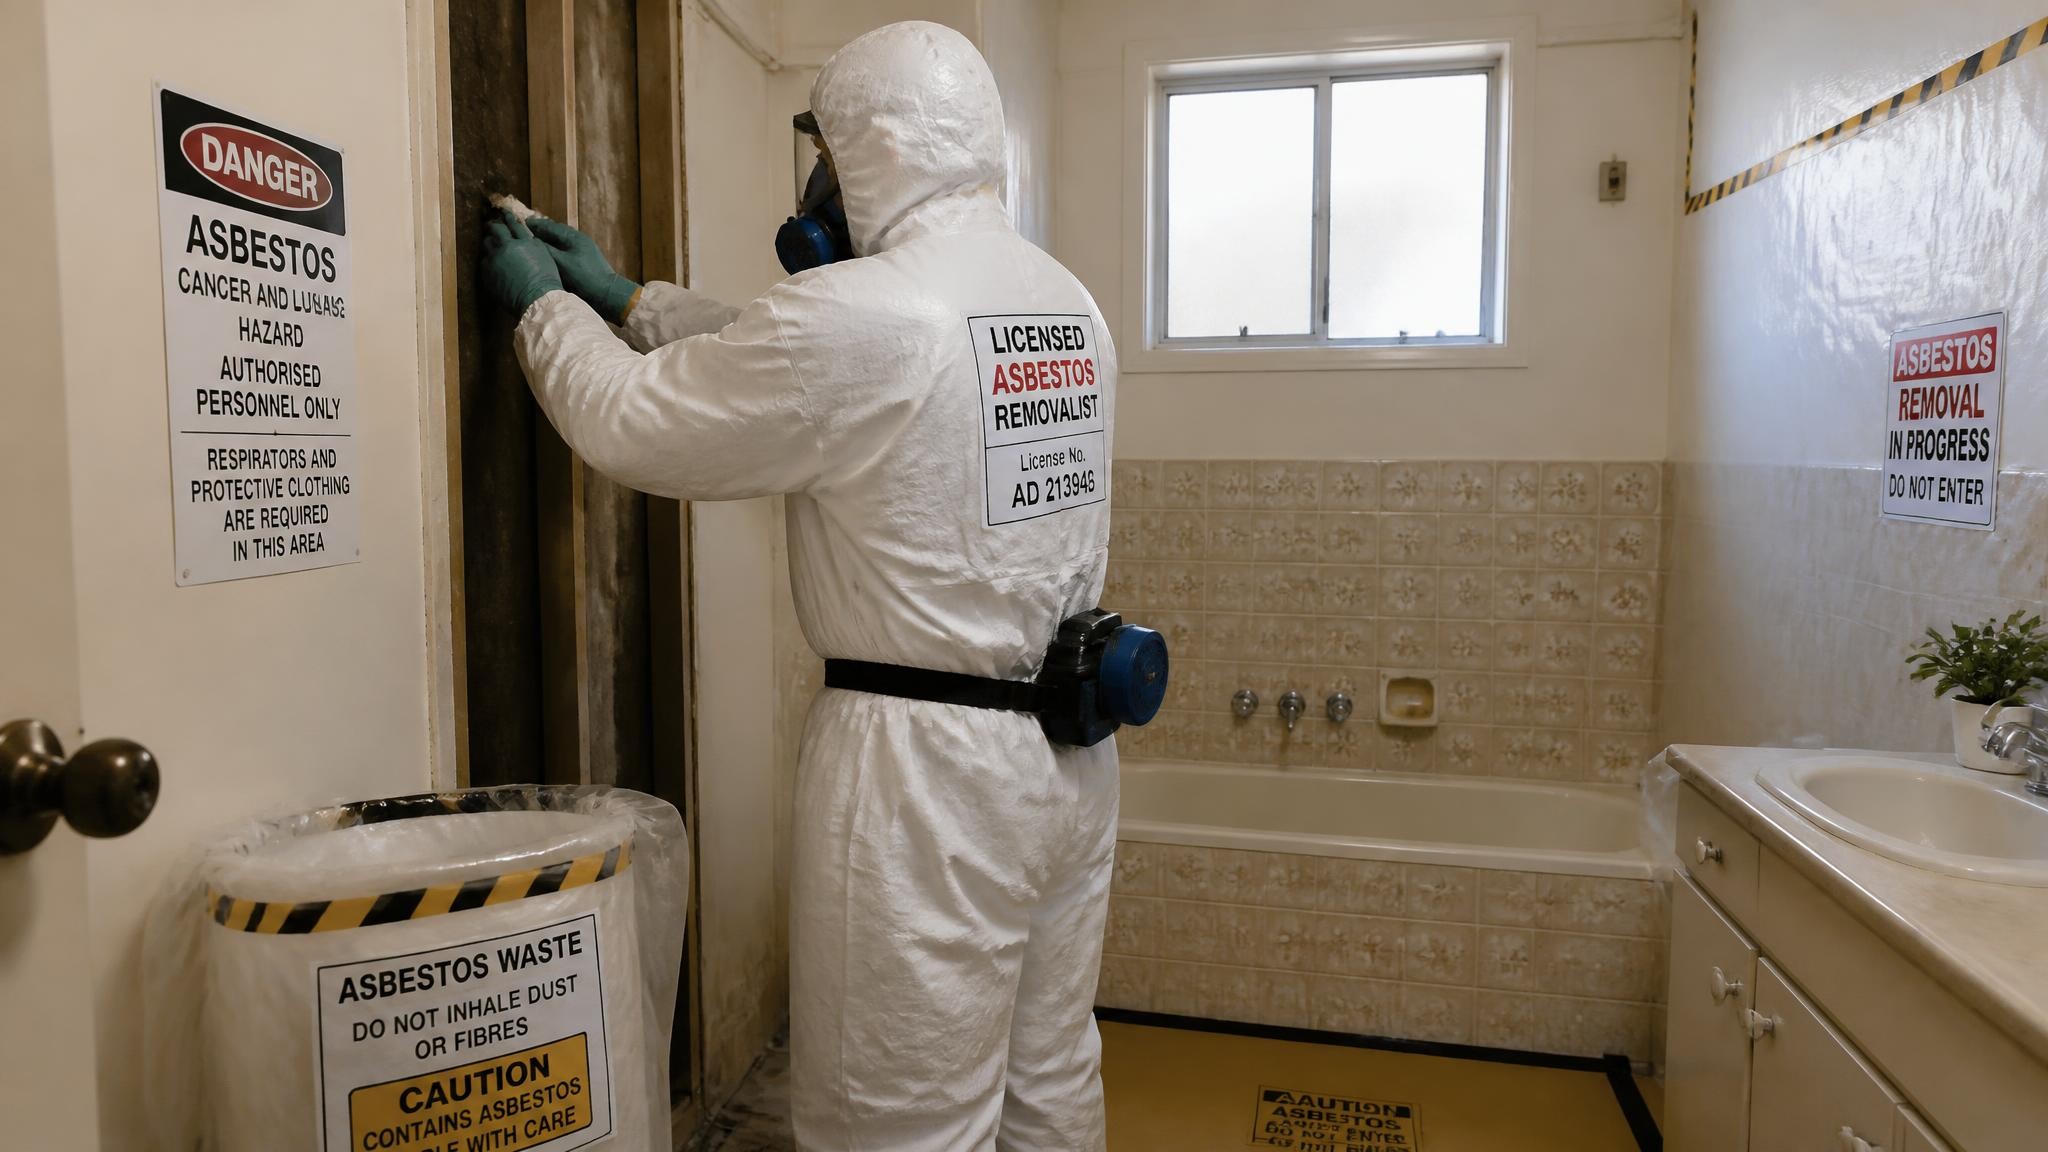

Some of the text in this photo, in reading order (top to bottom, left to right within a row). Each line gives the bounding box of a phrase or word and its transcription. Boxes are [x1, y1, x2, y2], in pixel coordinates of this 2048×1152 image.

[202, 133, 318, 202] DANGER
[186, 214, 336, 283] ASBESTOS
[178, 267, 252, 304] CANCER
[257, 283, 288, 309] AND
[239, 316, 304, 347] HAZARD
[990, 326, 1085, 353] LICENSED
[220, 356, 321, 387] AUTHORISED
[1897, 333, 1992, 376] ASBESTOS
[992, 359, 1095, 395] ASBESTOS
[197, 389, 340, 420] PERSONNEL ONLY
[995, 395, 1097, 430] REMOVALIST
[1899, 383, 1984, 421] REMOVAL
[208, 449, 336, 470] RESPIRATORS AND
[1021, 447, 1086, 471] License No.
[1889, 428, 1990, 461] IN PROGRESS
[191, 476, 350, 502] PROTECTIVE CLOTHING
[1012, 481, 1039, 508] AD
[1890, 474, 1984, 505] DO NOT ENTER
[224, 504, 329, 532] ARE REQUIRED
[233, 532, 325, 561] IN THIS AREA
[338, 930, 582, 1004] ASBESTOS WASTE
[353, 974, 578, 1042] DO NOT INHALE DUST
[415, 1017, 528, 1060] OR FIBRES
[400, 1054, 550, 1114] CAUTION
[363, 1077, 581, 1151] CONTAINS ASBESTOS
[467, 1105, 576, 1152] WITH CARE
[1272, 1106, 1401, 1130] ASBESTOS
